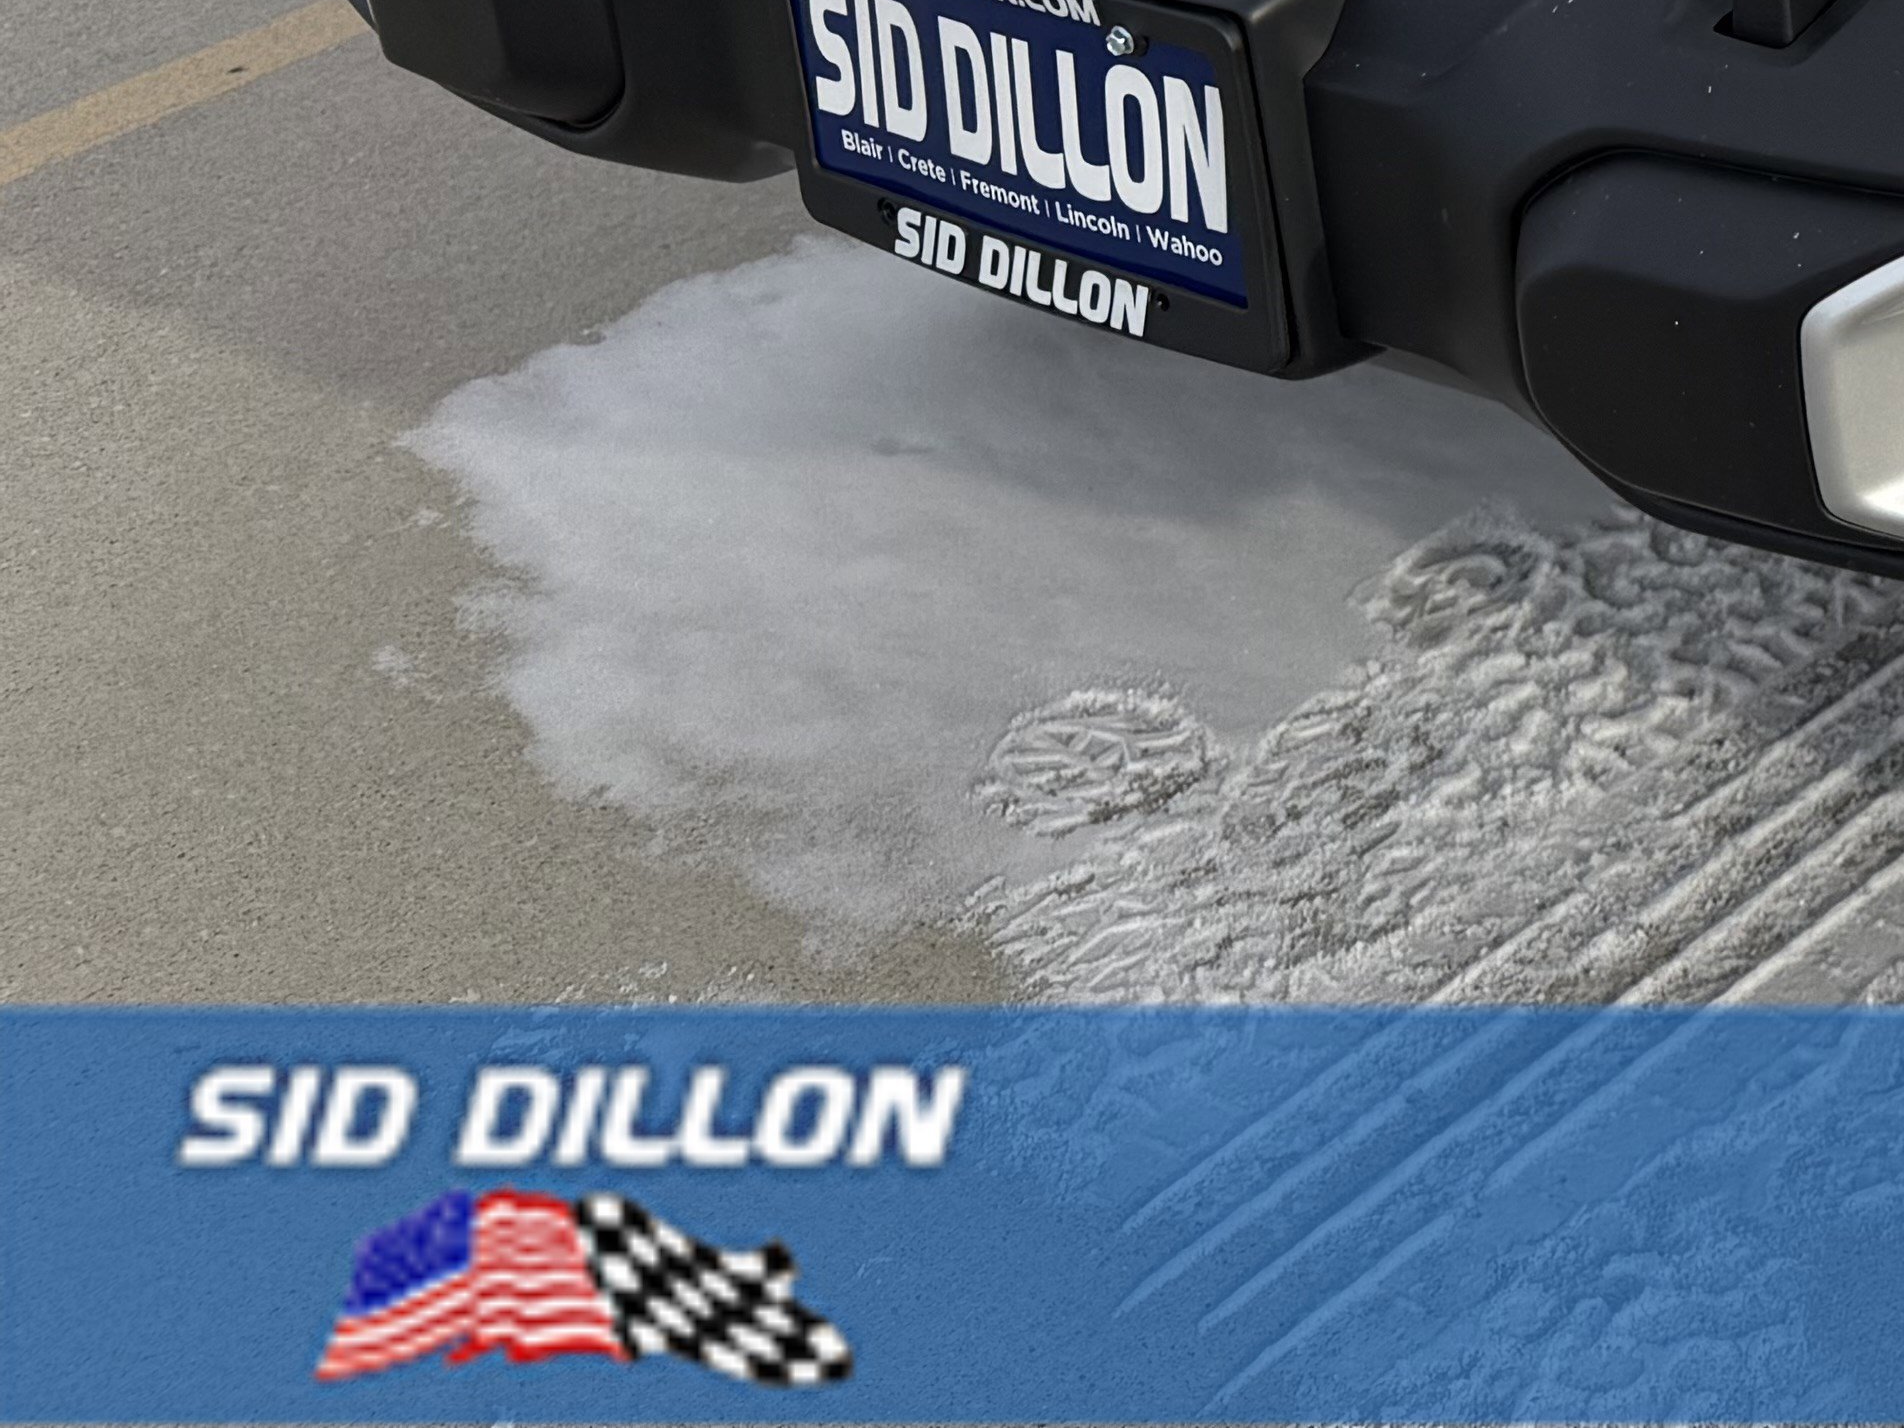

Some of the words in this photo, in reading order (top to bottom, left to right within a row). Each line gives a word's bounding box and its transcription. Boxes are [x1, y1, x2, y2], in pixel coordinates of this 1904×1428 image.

[937, 15, 1229, 234] DILLON
[841, 129, 884, 162] Blair
[897, 147, 947, 184] Crete
[960, 170, 1041, 216] Fremont
[1055, 200, 1131, 242] Lincoln
[1145, 229, 1224, 268] Wahoo
[894, 205, 967, 277] SID
[977, 234, 1150, 338] DILLON
